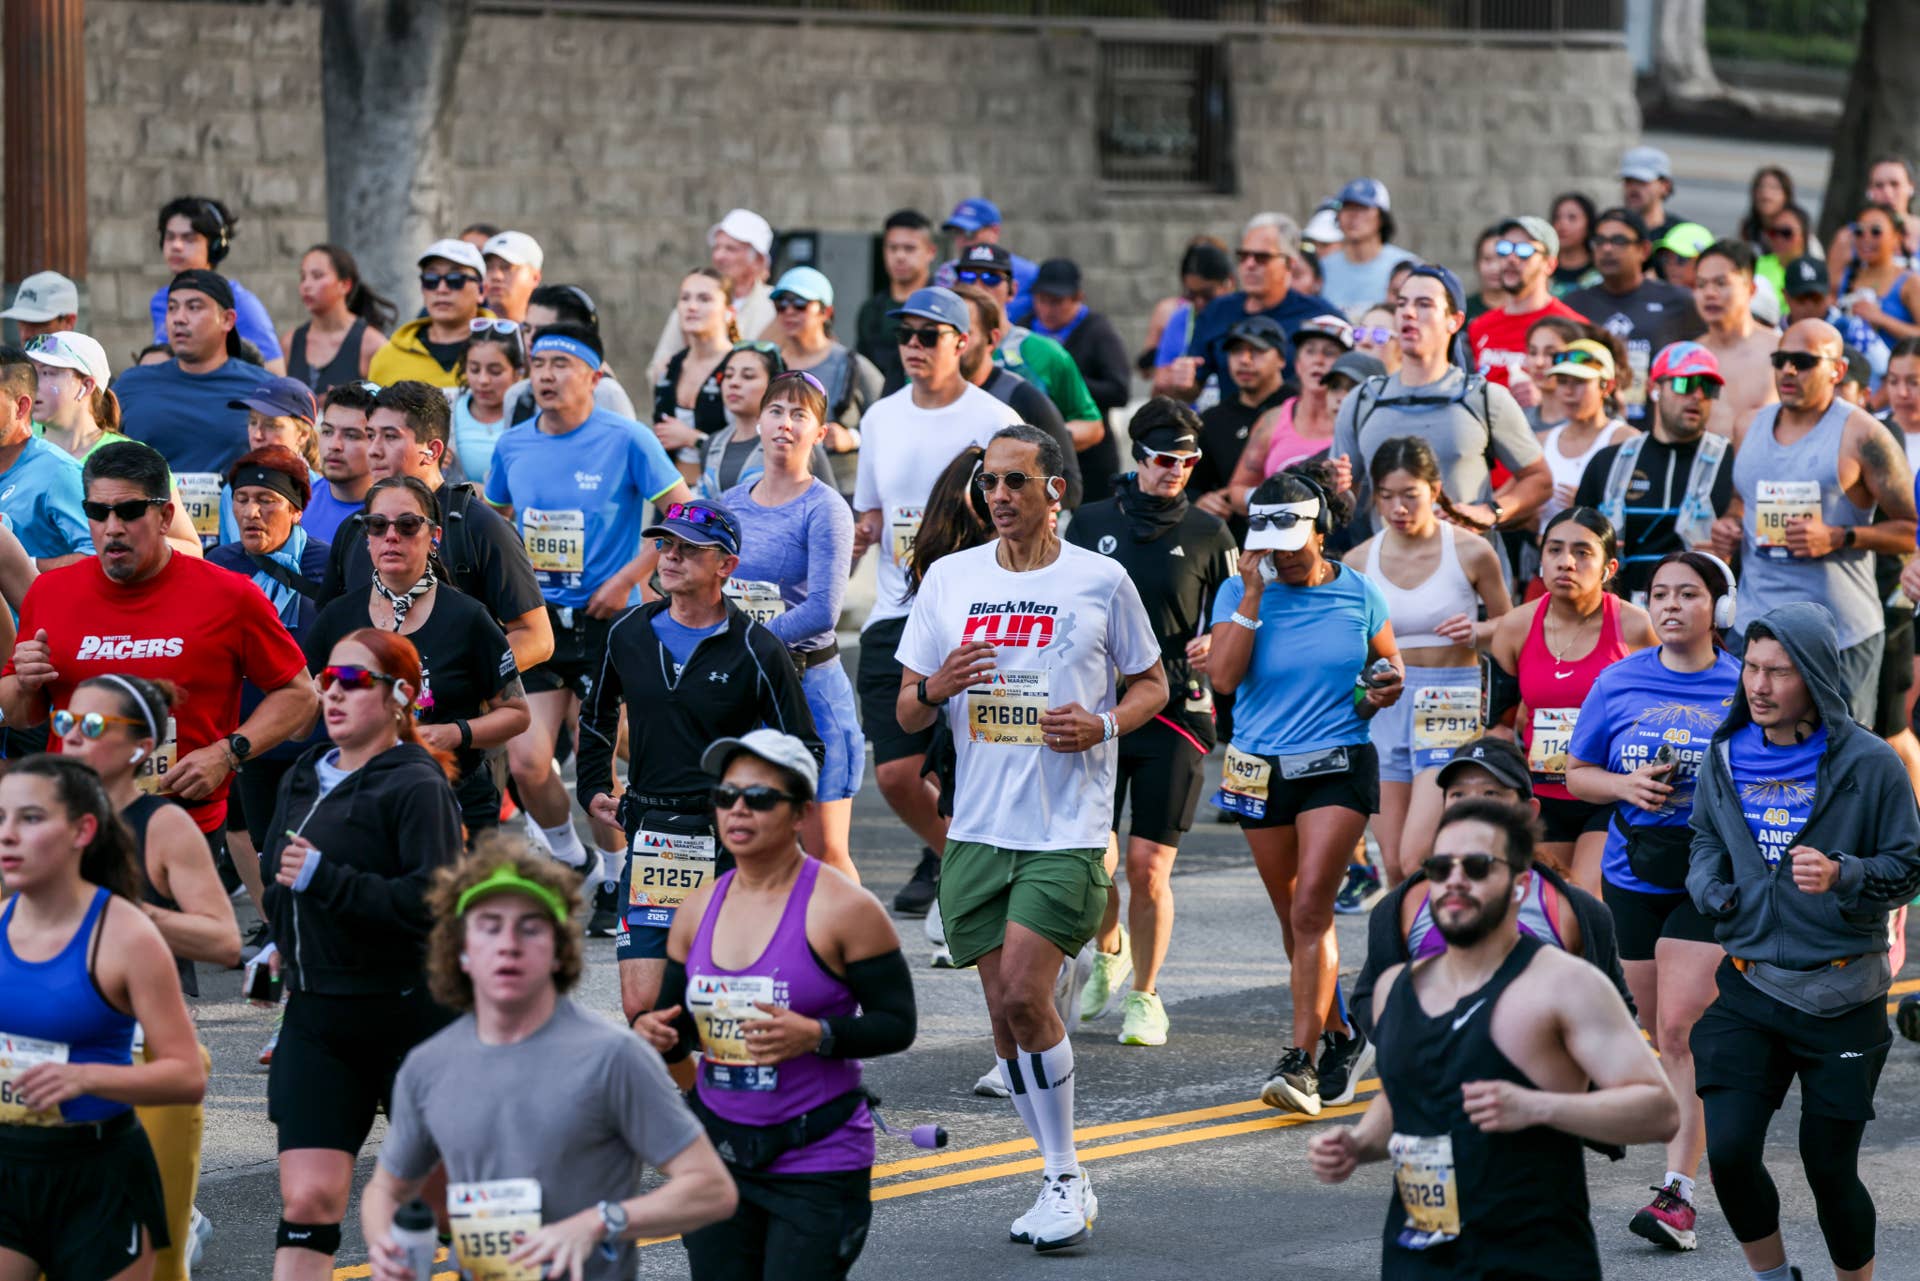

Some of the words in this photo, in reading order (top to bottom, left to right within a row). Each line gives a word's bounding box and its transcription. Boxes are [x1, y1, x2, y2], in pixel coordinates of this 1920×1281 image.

[961, 615, 1054, 648] run
[76, 635, 184, 660] PACERS
[977, 705, 1038, 725] 21680
[1425, 717, 1477, 732] E7914
[1663, 727, 1690, 744] 40
[1621, 744, 1648, 757] LOS
[1763, 808, 1789, 826] 40
[1758, 829, 1797, 844] ANG
[643, 867, 704, 888] 21257
[460, 1230, 526, 1257] 1355
